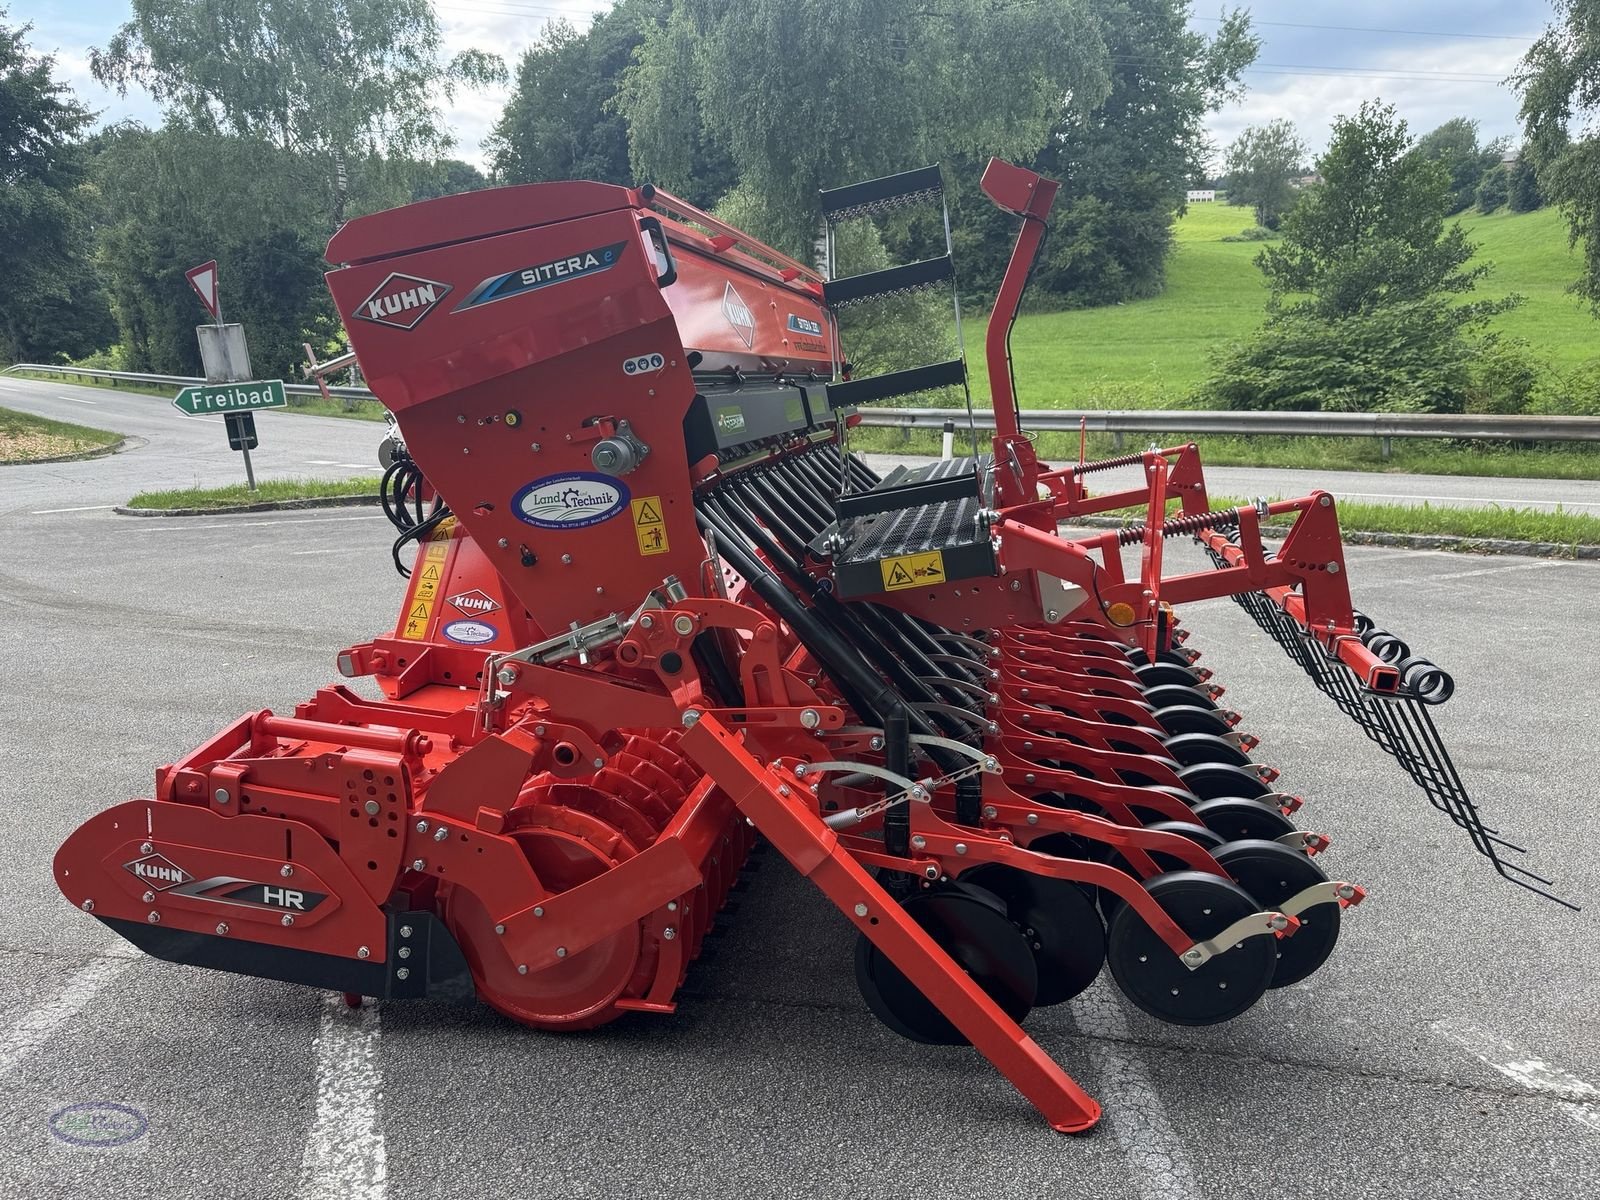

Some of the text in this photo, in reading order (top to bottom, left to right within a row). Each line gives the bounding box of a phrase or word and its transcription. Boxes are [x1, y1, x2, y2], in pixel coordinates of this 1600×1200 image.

[520, 253, 600, 285] SITERA
[368, 284, 436, 319] KUHN
[191, 385, 275, 410] Freibad
[533, 491, 561, 506] Land
[571, 491, 614, 508] Technik
[454, 597, 493, 610] KUHN
[134, 862, 183, 883] KUHN
[263, 886, 305, 910] HR
